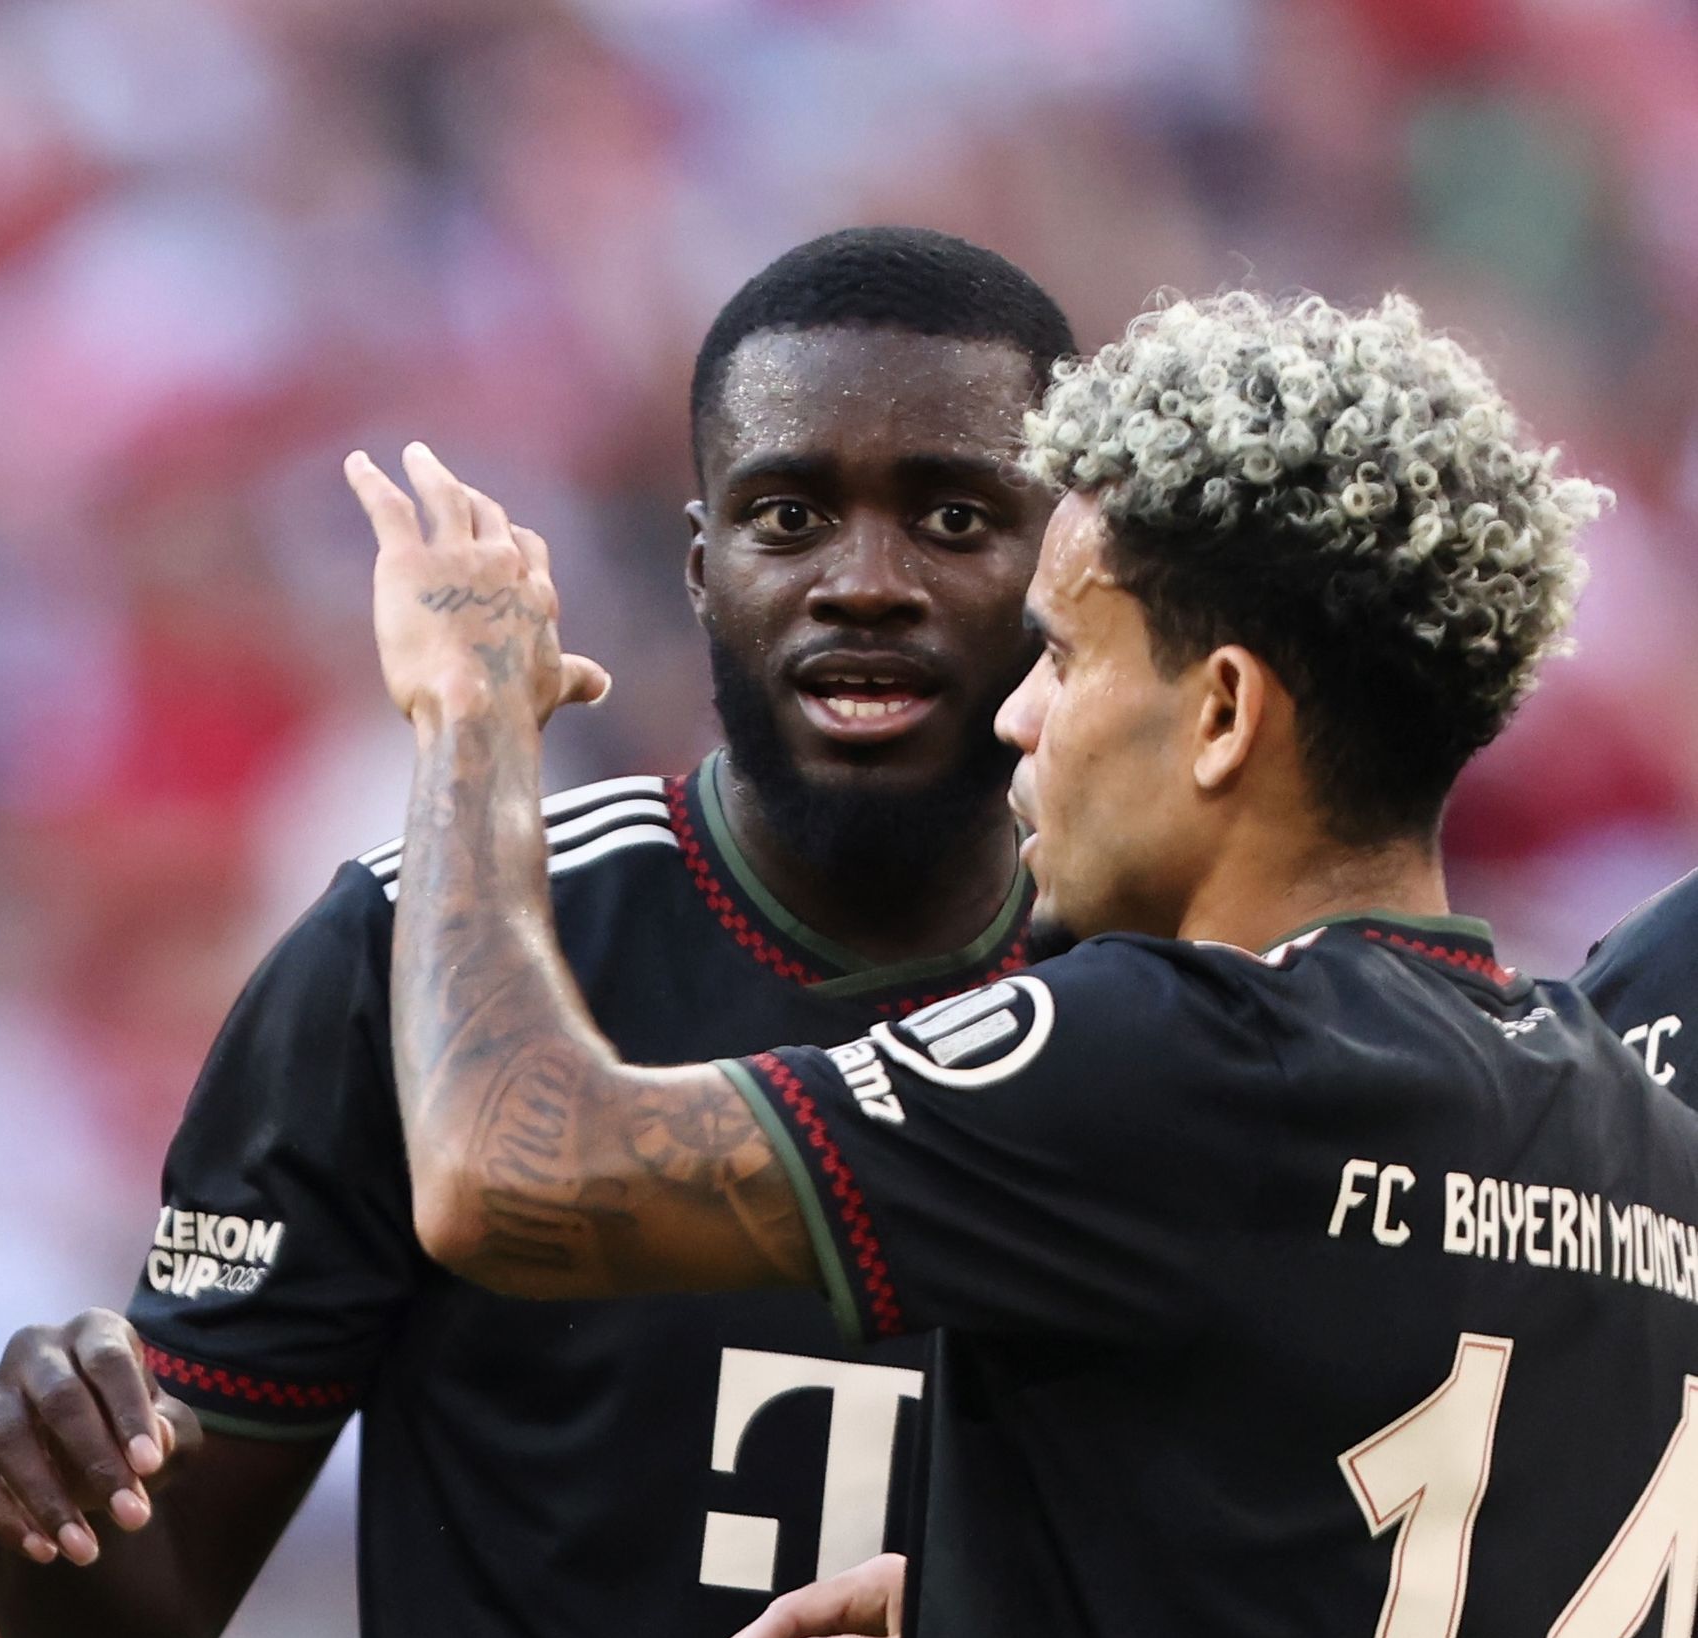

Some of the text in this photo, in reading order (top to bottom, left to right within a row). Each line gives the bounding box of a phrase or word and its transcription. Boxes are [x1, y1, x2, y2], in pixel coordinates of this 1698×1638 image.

[1327, 1158, 1416, 1247] FC
[1443, 1171, 1602, 1276] BAYERN
[147, 1249, 219, 1300] CUP
